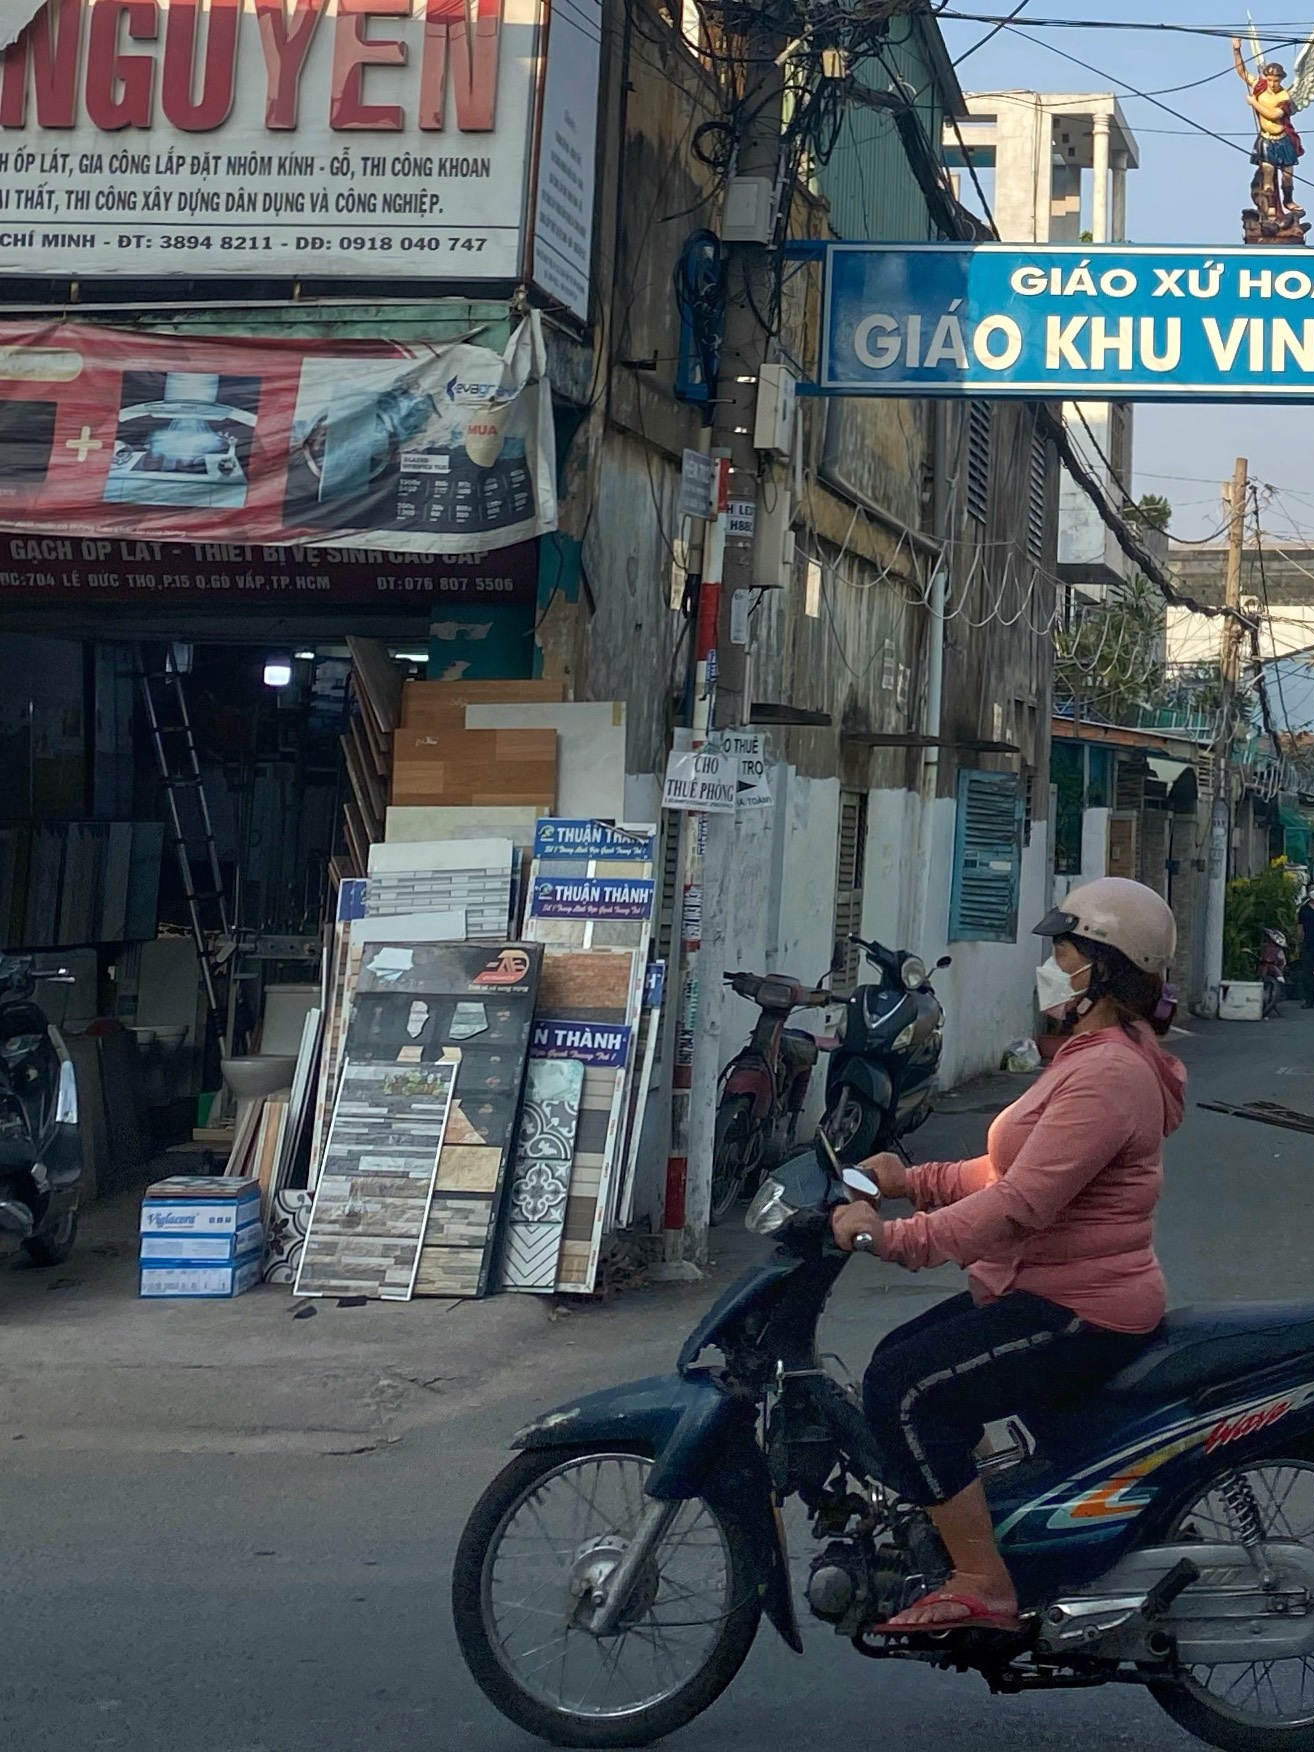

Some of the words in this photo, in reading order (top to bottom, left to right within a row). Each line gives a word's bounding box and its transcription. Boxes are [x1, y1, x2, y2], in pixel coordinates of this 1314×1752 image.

[14, 145, 35, 173] ỐP
[40, 148, 73, 177] LÁT,
[79, 153, 103, 174] GIA
[109, 149, 150, 174] CÔNG
[155, 146, 186, 175] LẮP
[190, 152, 221, 181] ĐẶT
[226, 151, 272, 177] NHÔM
[277, 151, 314, 177] KÍNH
[330, 147, 355, 180] GỖ,
[361, 156, 386, 177] THI
[391, 152, 433, 178] CÔNG
[438, 157, 490, 178] KHOAN
[15, 182, 59, 213] THẤT,
[65, 190, 90, 211] THI
[95, 186, 136, 212] CÔNG
[141, 186, 173, 212] XÂY
[177, 188, 220, 216] DỰNG
[225, 187, 257, 213] DÂN
[262, 191, 305, 217] DỤNG
[310, 187, 329, 213] VÀ
[335, 188, 376, 213] CÔNG
[381, 189, 444, 218] NGHIỆP.
[0, 230, 34, 247] CHÍ
[42, 233, 96, 248] MINH
[118, 235, 152, 249] ĐT:
[159, 235, 213, 250] 3894
[220, 236, 272, 250] 8211
[296, 237, 332, 250] DĐ:
[339, 237, 392, 251] 0918
[400, 237, 441, 251] 040
[448, 238, 488, 252] 747
[1010, 260, 1138, 298] GIÁO
[1152, 260, 1226, 298] XỨ
[853, 299, 1023, 371] GIÁO
[1045, 315, 1182, 373] KHU
[467, 424, 498, 436] MUA
[10, 540, 73, 564] GẠCH
[439, 577, 468, 592] 807
[475, 577, 514, 592] 5506
[734, 736, 759, 754] THUÊ
[694, 756, 719, 774] CHO
[742, 760, 764, 779] TRỌ
[667, 777, 698, 799] THUÊ
[557, 824, 602, 845] THUẬN
[555, 883, 600, 905] THUẬN
[603, 884, 649, 904] THÀNH
[555, 1027, 622, 1050] THÀNH
